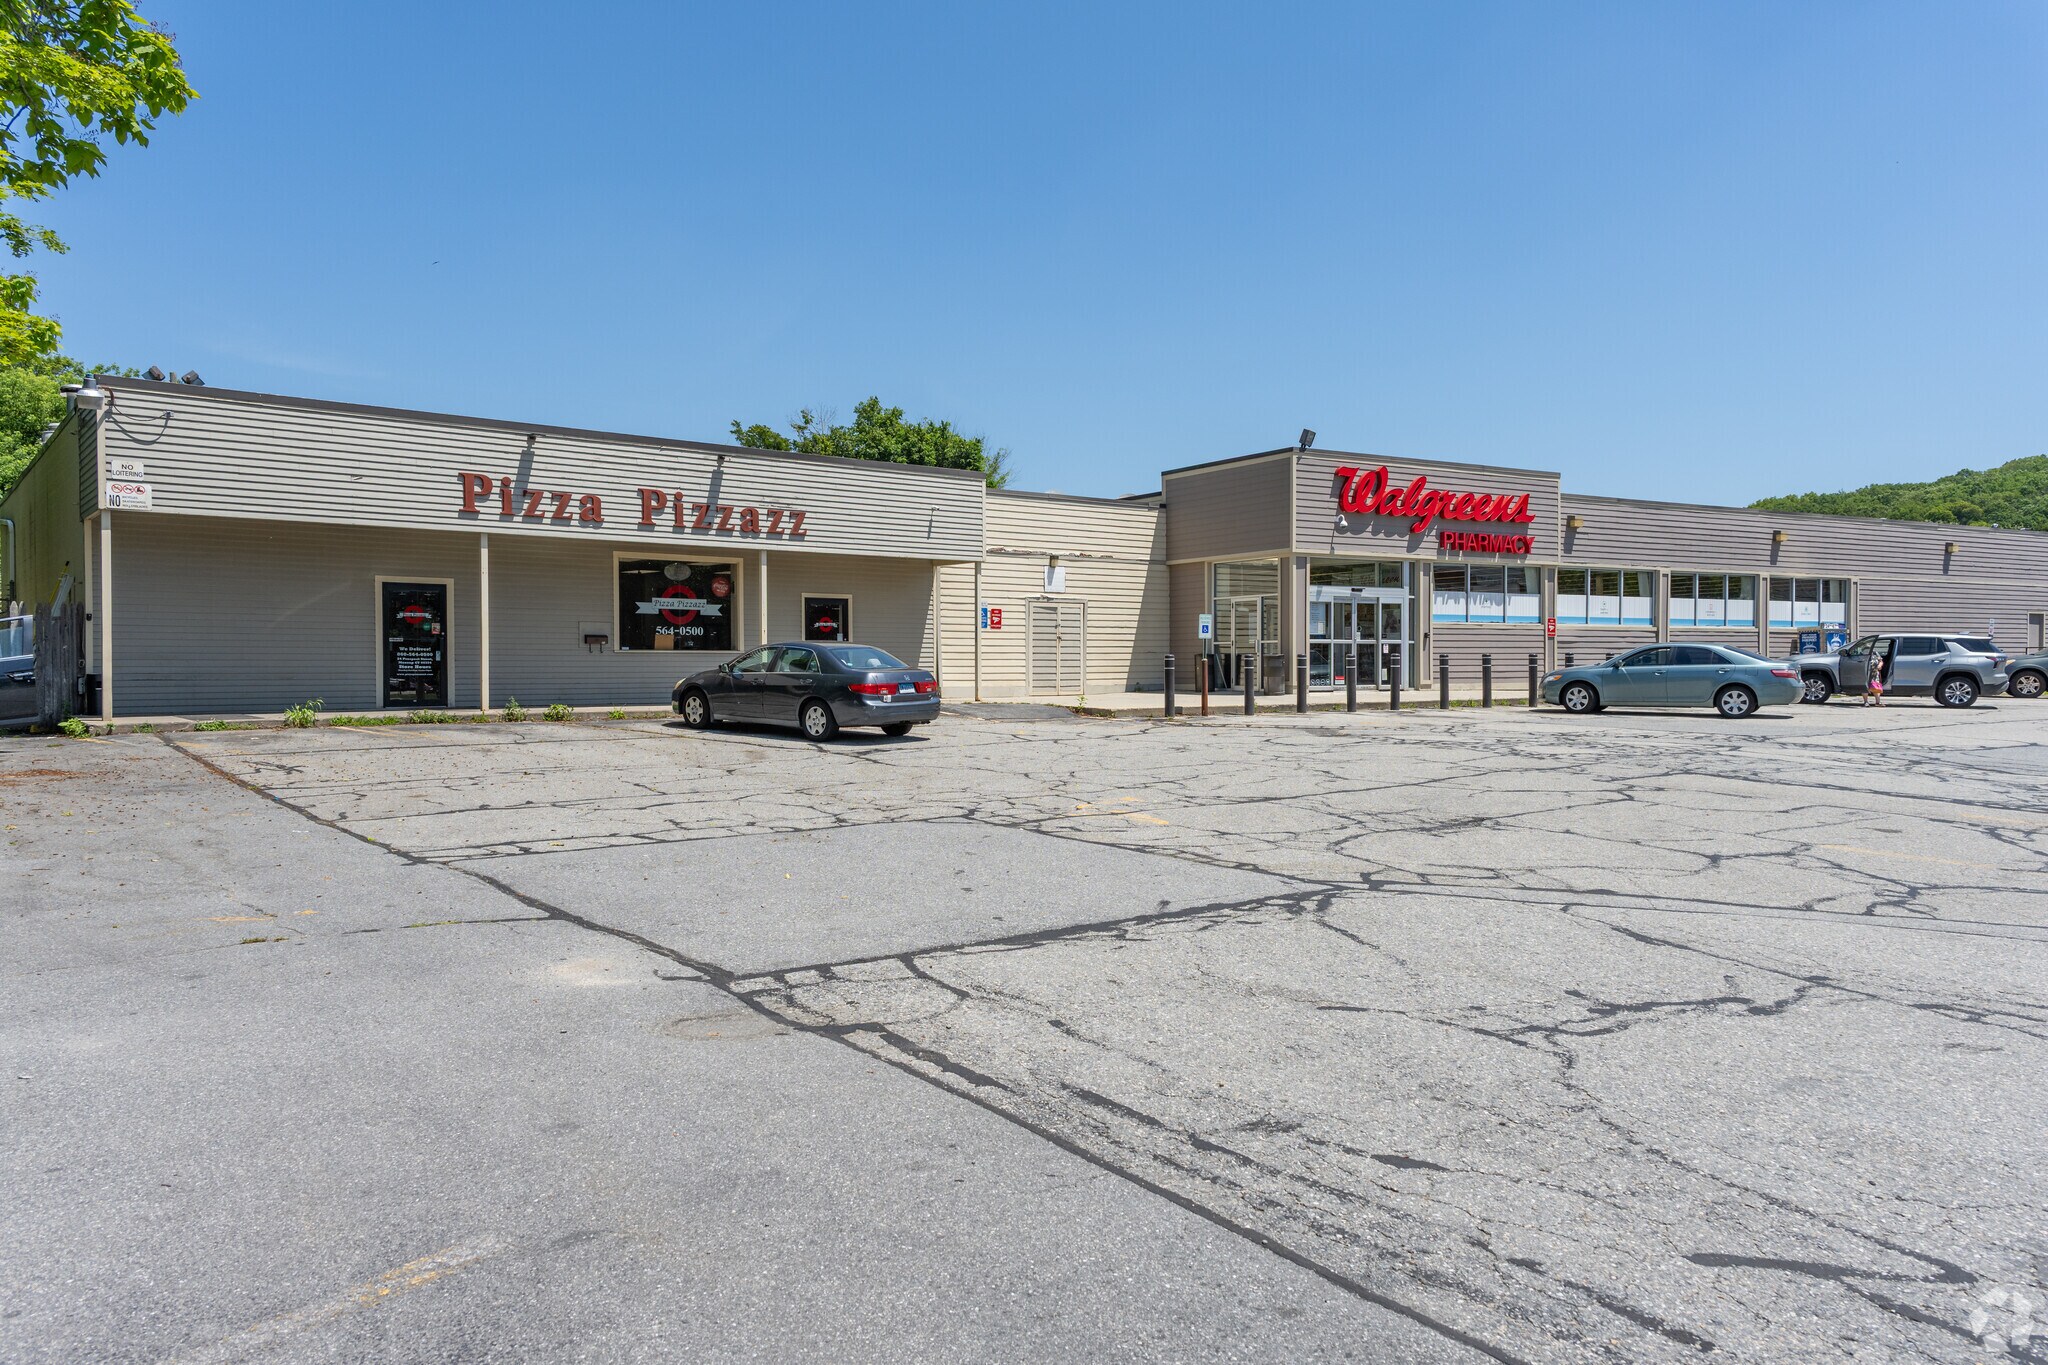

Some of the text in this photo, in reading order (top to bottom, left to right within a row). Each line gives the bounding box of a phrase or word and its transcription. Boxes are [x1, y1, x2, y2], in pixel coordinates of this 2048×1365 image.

[112, 470, 143, 478] LOITERING
[109, 495, 121, 507] NO
[458, 472, 807, 536] Pizza Pizzazz
[1335, 465, 1536, 534] Walgreens
[1440, 531, 1536, 554] PHARMACY
[653, 599, 706, 609] Pizza Pizzazz
[655, 626, 704, 636] 564-0500
